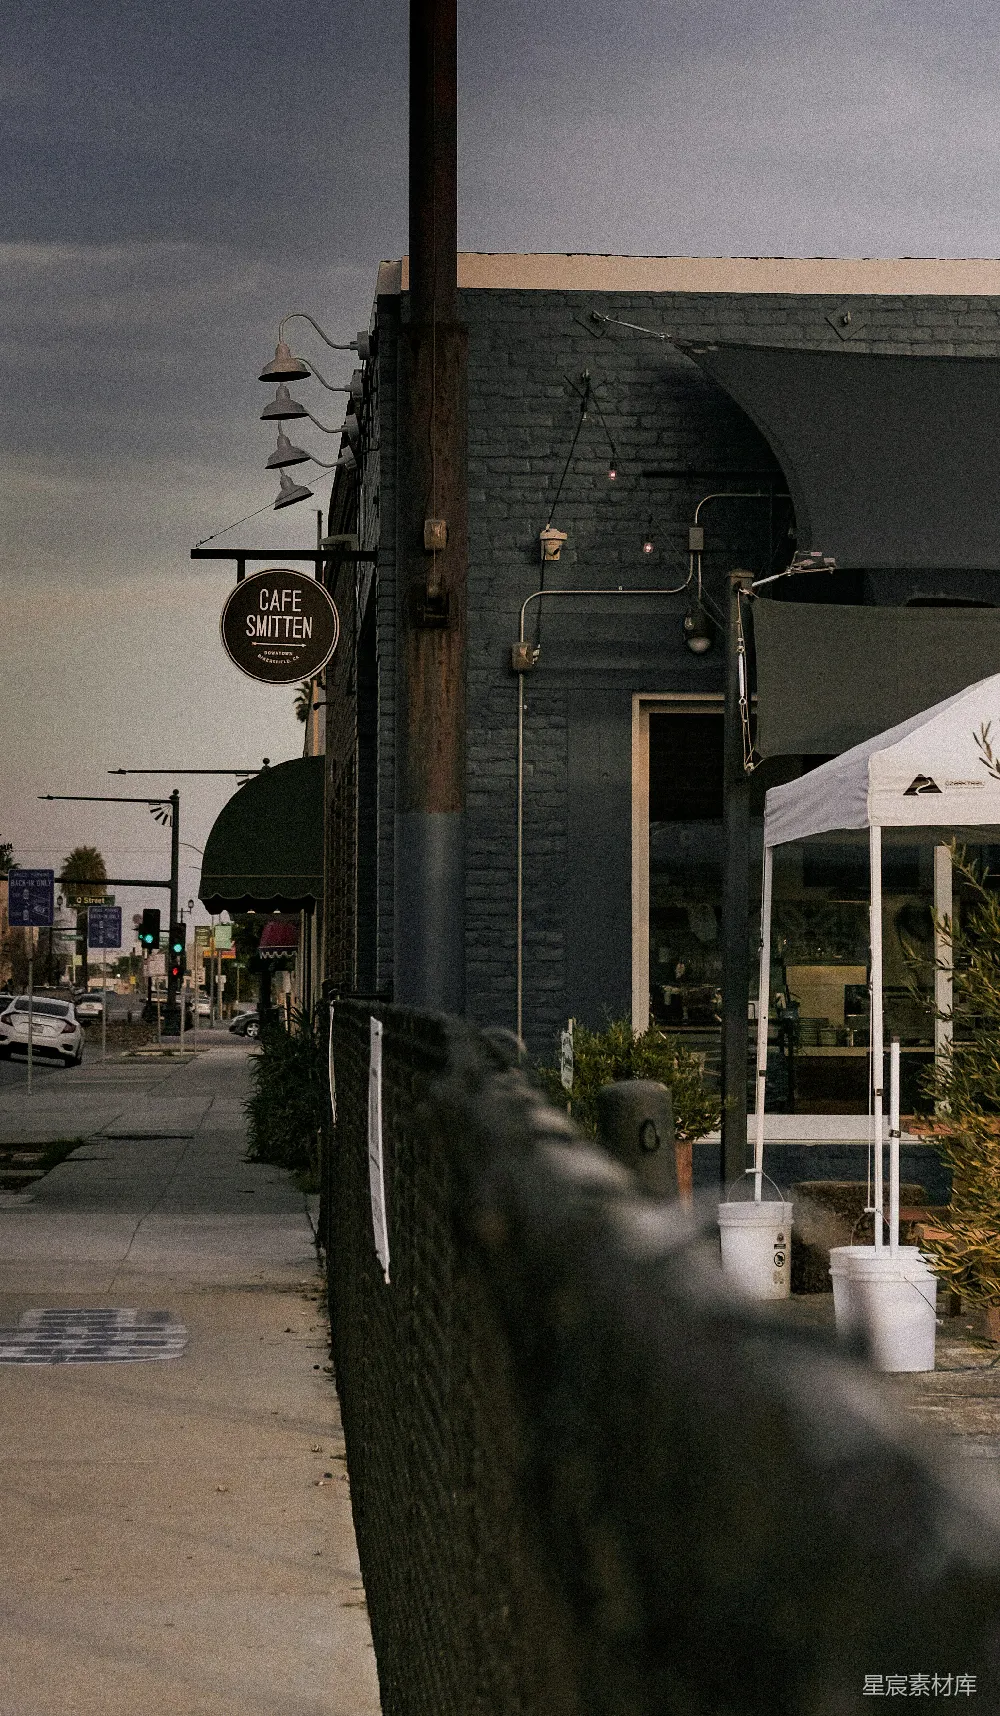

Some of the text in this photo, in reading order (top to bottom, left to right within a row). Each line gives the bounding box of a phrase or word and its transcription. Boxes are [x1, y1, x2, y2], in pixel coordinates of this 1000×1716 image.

[259, 588, 302, 612] CAFE
[245, 614, 313, 639] SMITTEN
[36, 879, 51, 887] ONLY
